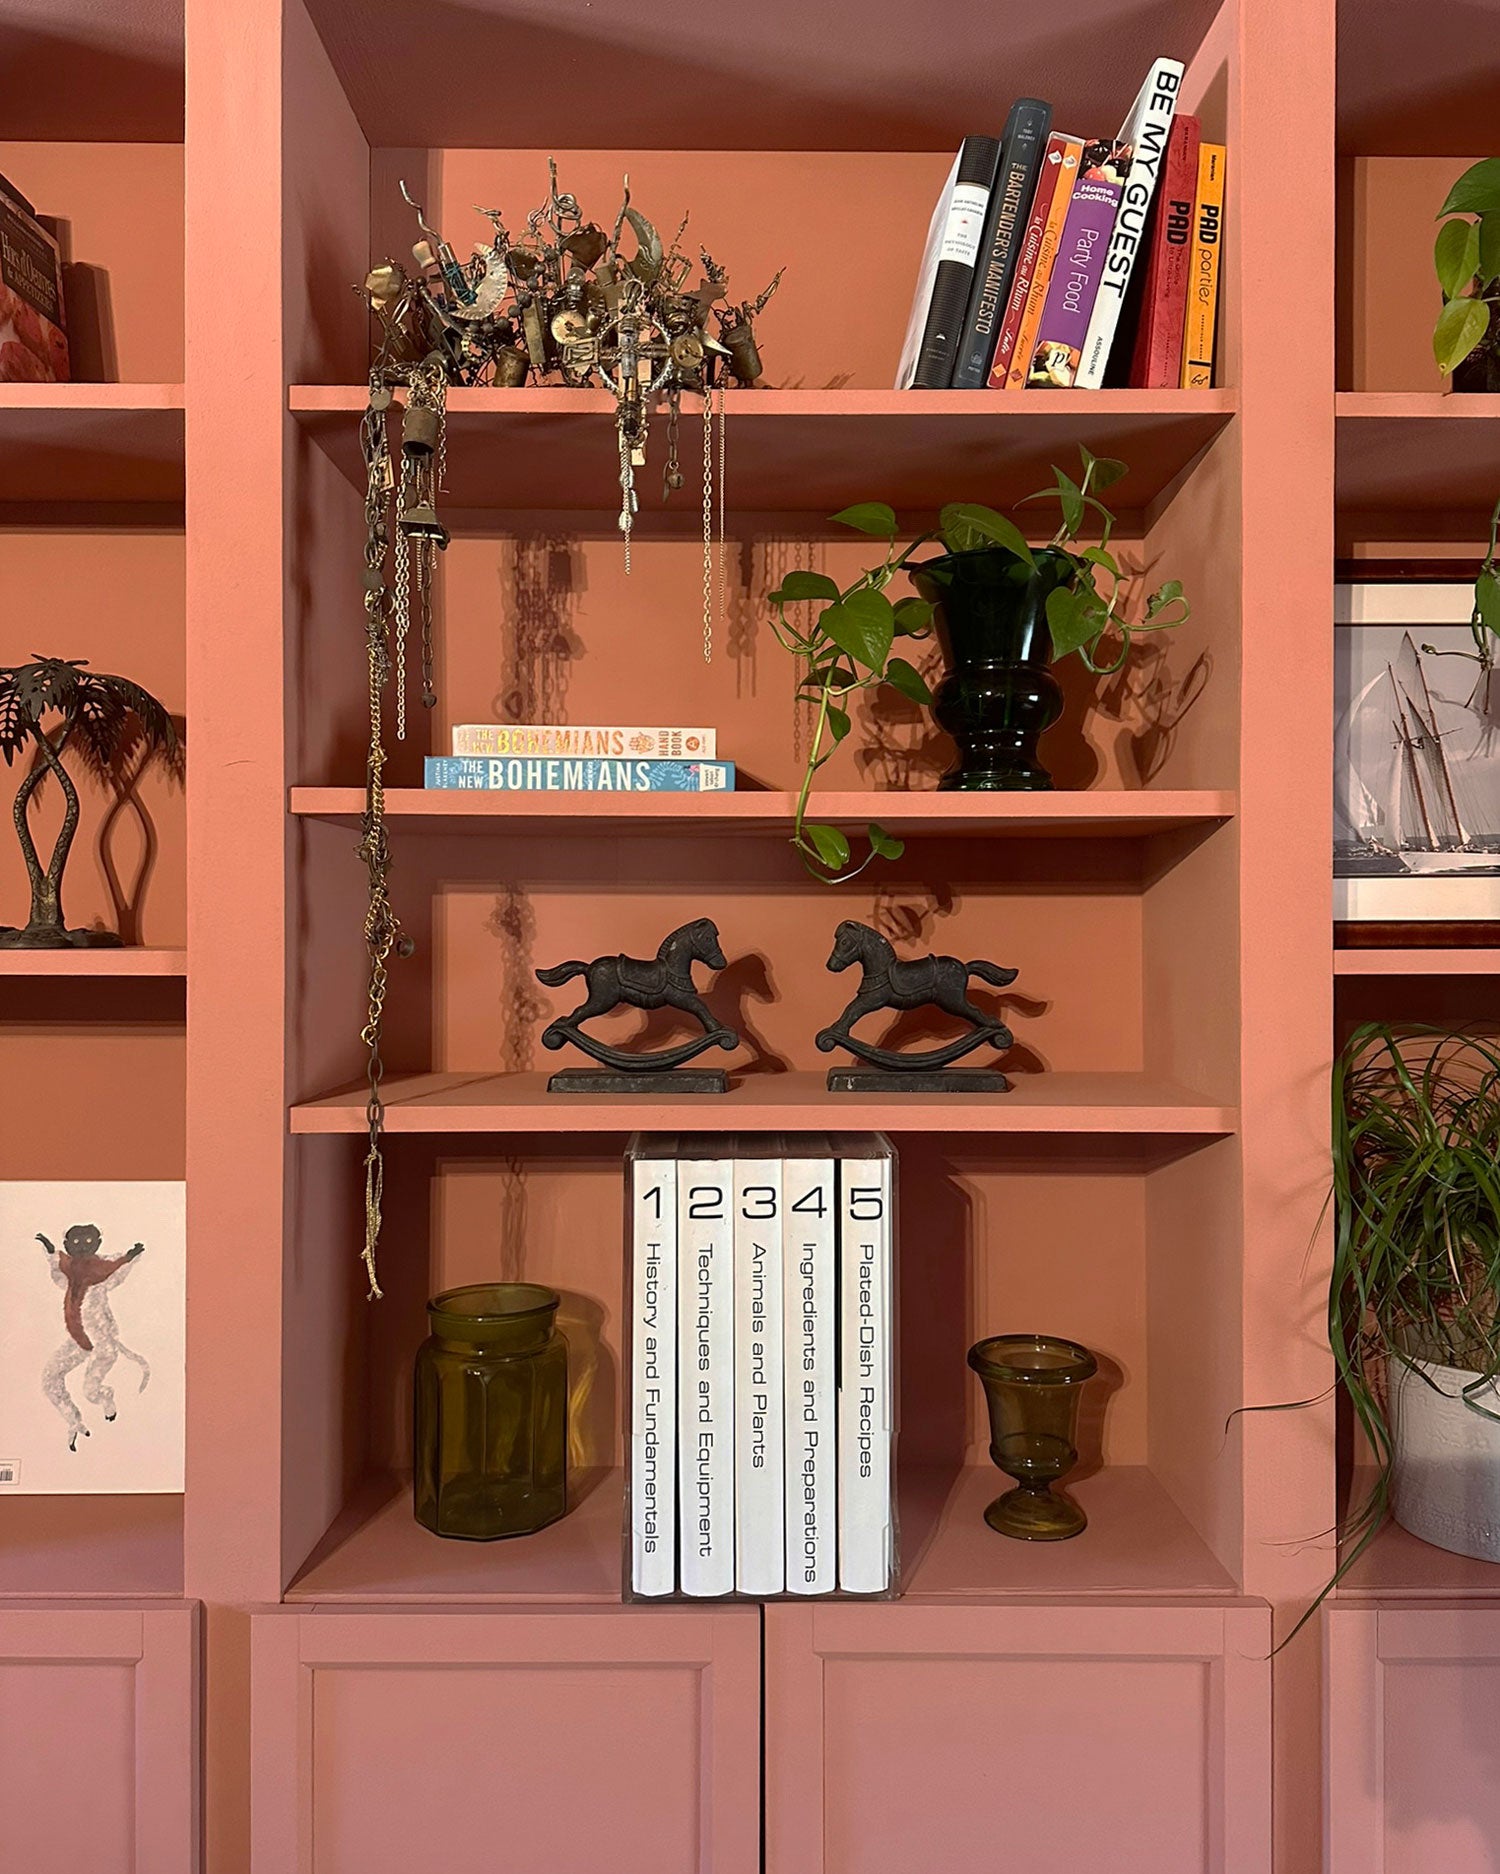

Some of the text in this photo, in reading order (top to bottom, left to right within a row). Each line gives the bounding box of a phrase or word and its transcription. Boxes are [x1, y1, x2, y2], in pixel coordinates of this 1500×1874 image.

[1072, 192, 1119, 207] Cooking
[1081, 184, 1114, 196] Home
[1103, 70, 1179, 299] BE MY GUEST
[1167, 200, 1191, 245] PAD
[975, 162, 1027, 335] THE BARTENDER'S MANIFESTO
[1022, 224, 1043, 267] Cuisine
[1037, 229, 1057, 270] Cuisine
[1198, 203, 1220, 306] PAD parties
[1063, 228, 1099, 314] Party Food
[1011, 277, 1029, 311] Rhum
[1027, 279, 1044, 315] Rhum
[1088, 336, 1103, 376] ASSOULINE
[472, 742, 493, 754] NEW
[476, 729, 493, 740] THE
[497, 728, 624, 755] BOHEMIANS
[659, 730, 669, 756] HAND
[671, 730, 682, 756] BOOK
[458, 775, 484, 789] NEW
[461, 760, 483, 773] THE
[488, 759, 650, 790] BOHEMIANS
[643, 1186, 661, 1219] 1
[689, 1186, 723, 1219] 2
[742, 1186, 776, 1220] 3
[791, 1186, 827, 1219] 4
[849, 1187, 883, 1220] 5
[752, 1243, 767, 1469] Animals and Plants
[857, 1244, 875, 1478] Plated-Dish Recipes
[643, 1243, 661, 1553] History and Fundamentals
[696, 1243, 714, 1557] Techniques and Equipment
[800, 1243, 819, 1583] Ingredients and Preparations
